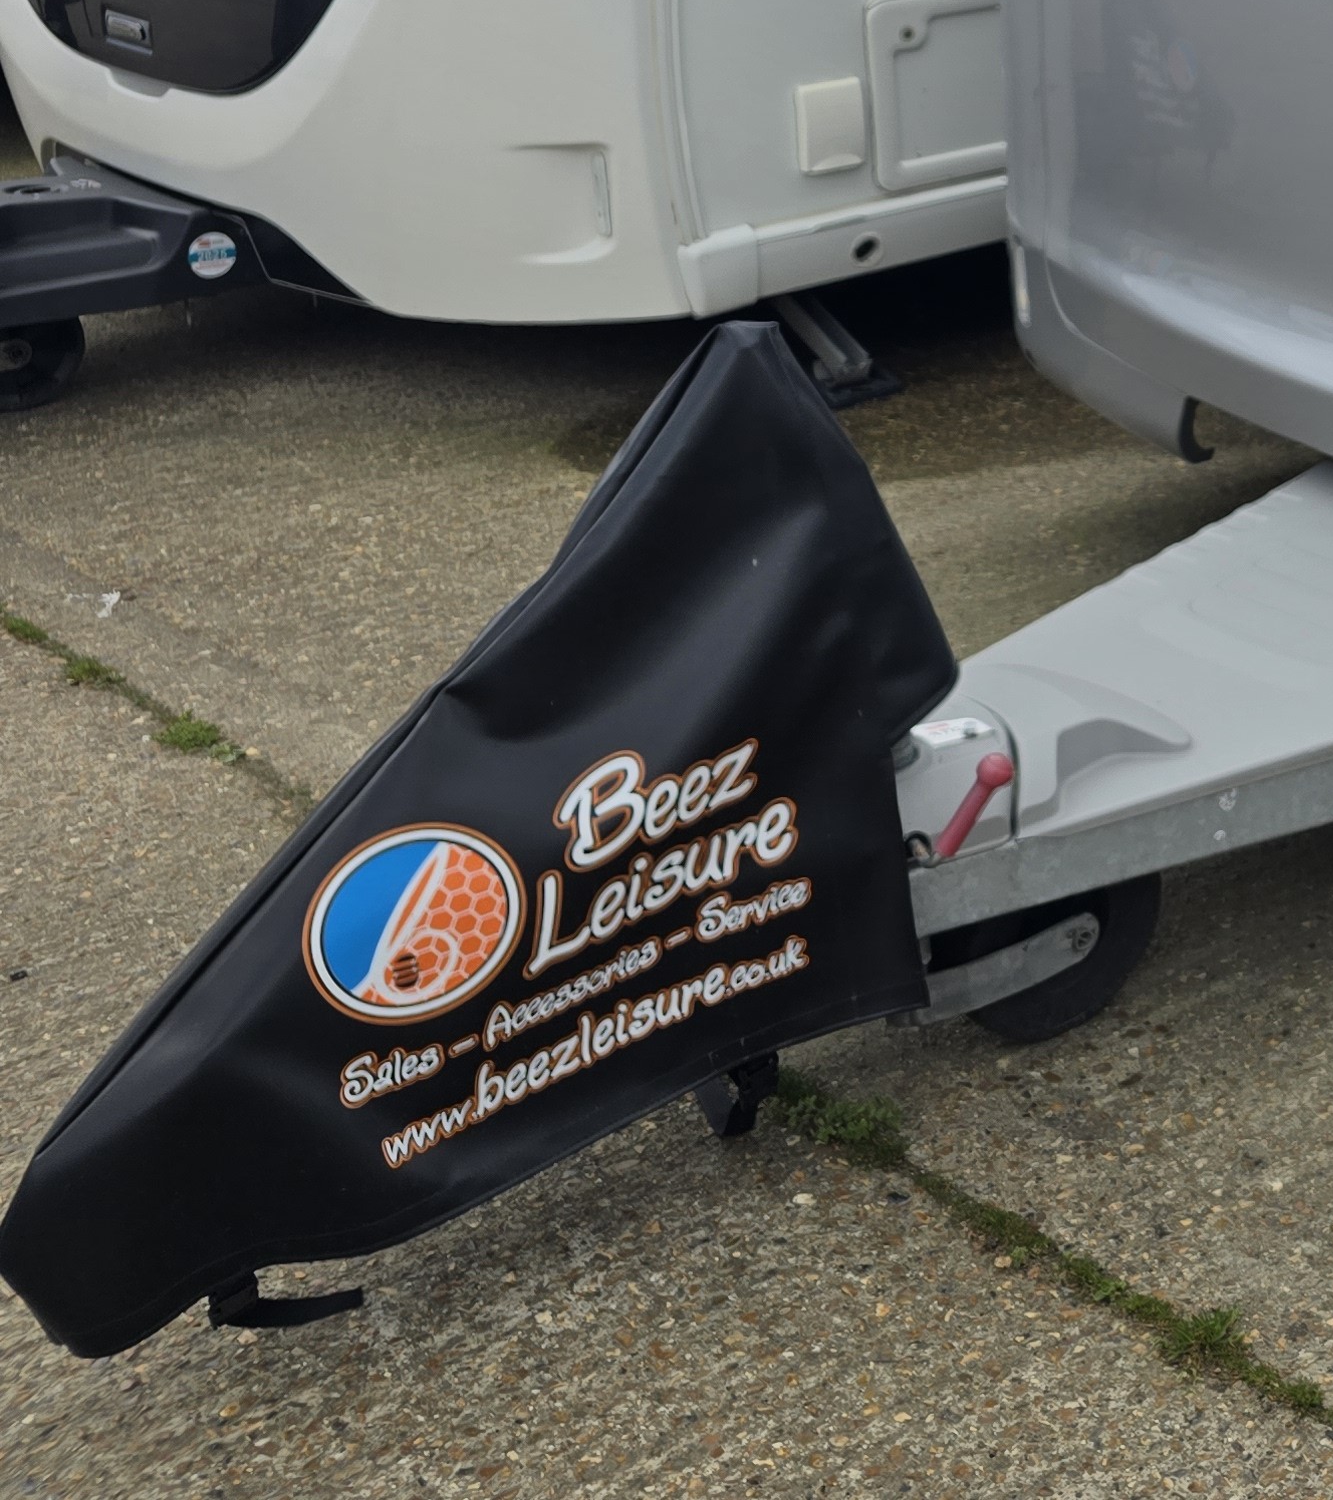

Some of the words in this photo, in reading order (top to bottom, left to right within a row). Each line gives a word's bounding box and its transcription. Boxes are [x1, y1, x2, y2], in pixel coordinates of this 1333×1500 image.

[525, 799, 797, 978] Leisure
[555, 740, 758, 870] Beez
[342, 1046, 441, 1106] Sales
[486, 938, 660, 1049] Accessories
[697, 878, 810, 942] Service
[384, 939, 808, 1166] www.beezleisure.co.uk
